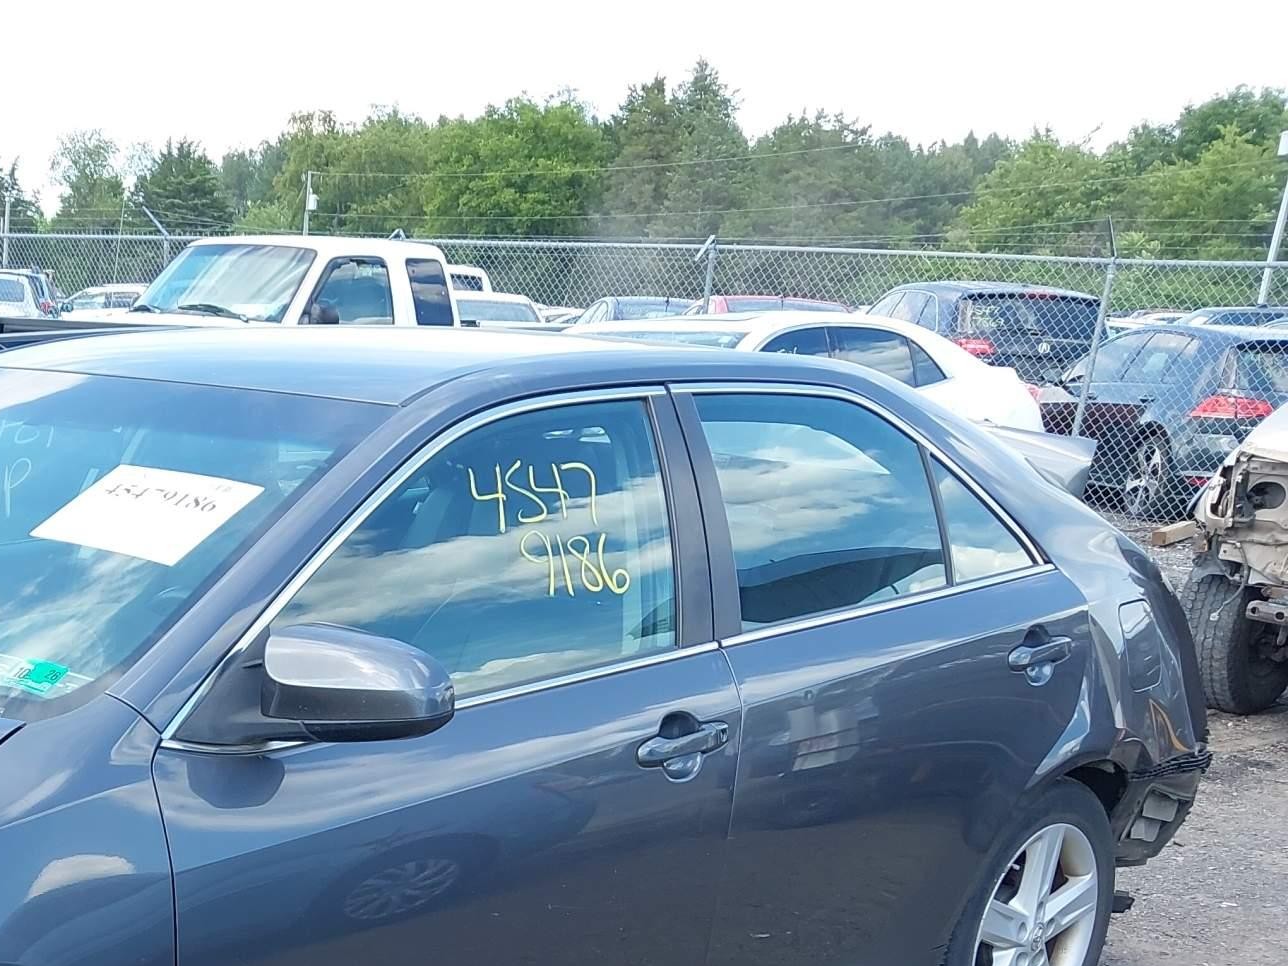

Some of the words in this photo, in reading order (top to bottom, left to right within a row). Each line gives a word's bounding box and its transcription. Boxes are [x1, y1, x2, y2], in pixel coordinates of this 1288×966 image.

[467, 459, 599, 534] 4547
[520, 529, 631, 597] 9186
[44, 668, 62, 682] 26
